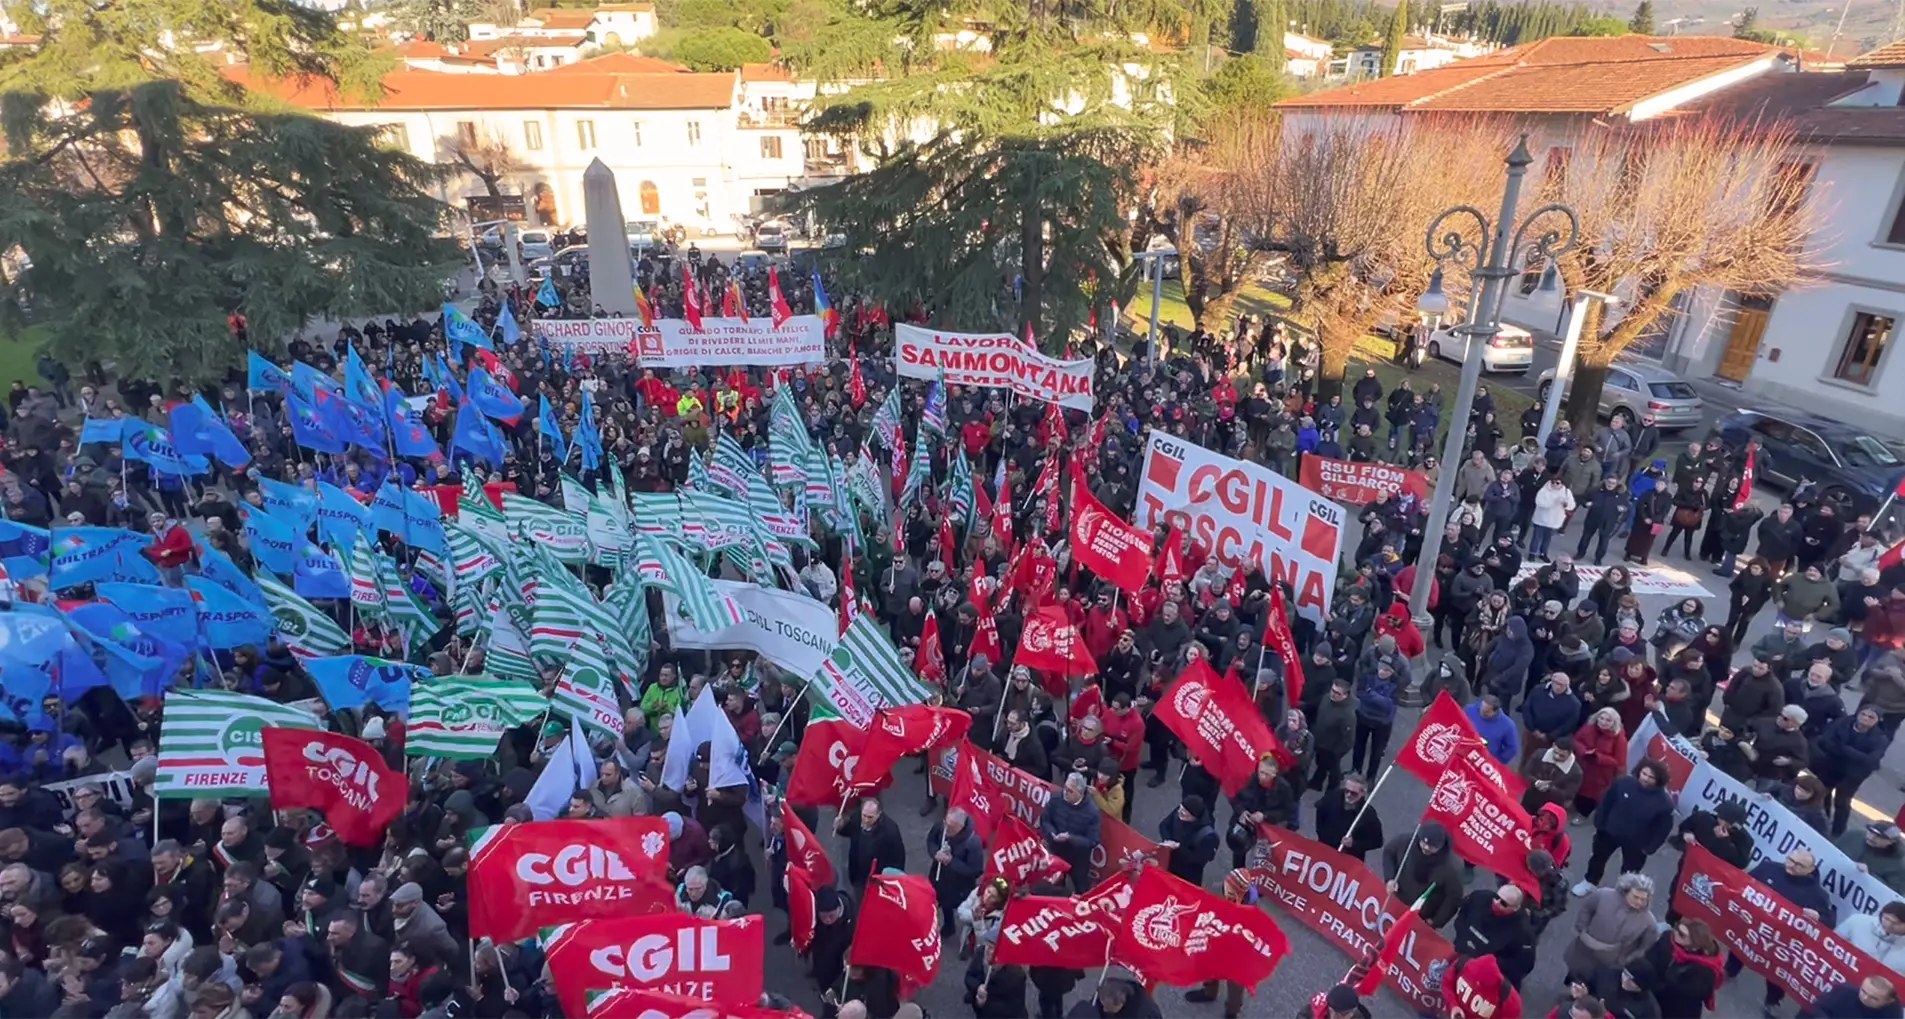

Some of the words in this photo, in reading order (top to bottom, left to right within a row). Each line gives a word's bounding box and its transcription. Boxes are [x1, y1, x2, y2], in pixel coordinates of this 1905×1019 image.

[688, 337, 699, 346] DI
[701, 337, 745, 346] RIVEDERE
[701, 347, 713, 356] DI
[901, 343, 1091, 397] SAMMONTANA
[1152, 438, 1186, 462] CGIL
[1320, 460, 1356, 474] RSU
[1361, 466, 1405, 483] FIOM
[1320, 470, 1400, 493] GILBARCO
[1189, 463, 1293, 543] CGIL
[1308, 500, 1340, 525] CGIL
[1144, 491, 1326, 617] TOSCANA
[230, 728, 263, 744] CIS
[184, 771, 249, 787] FIRENZE
[301, 740, 380, 804] CGIL
[987, 760, 1016, 788] RSU
[306, 765, 373, 812] TOSCANA
[1778, 830, 1813, 856] DE
[516, 843, 636, 886] CGIL
[528, 886, 633, 908] FIRENZE
[1727, 899, 1753, 925] ES
[1741, 884, 1777, 915] RSU
[1777, 907, 1821, 942] FIOM
[1822, 936, 1861, 973] CGIL
[589, 925, 731, 984] CGIL
[1725, 929, 1771, 969] CAMPI
